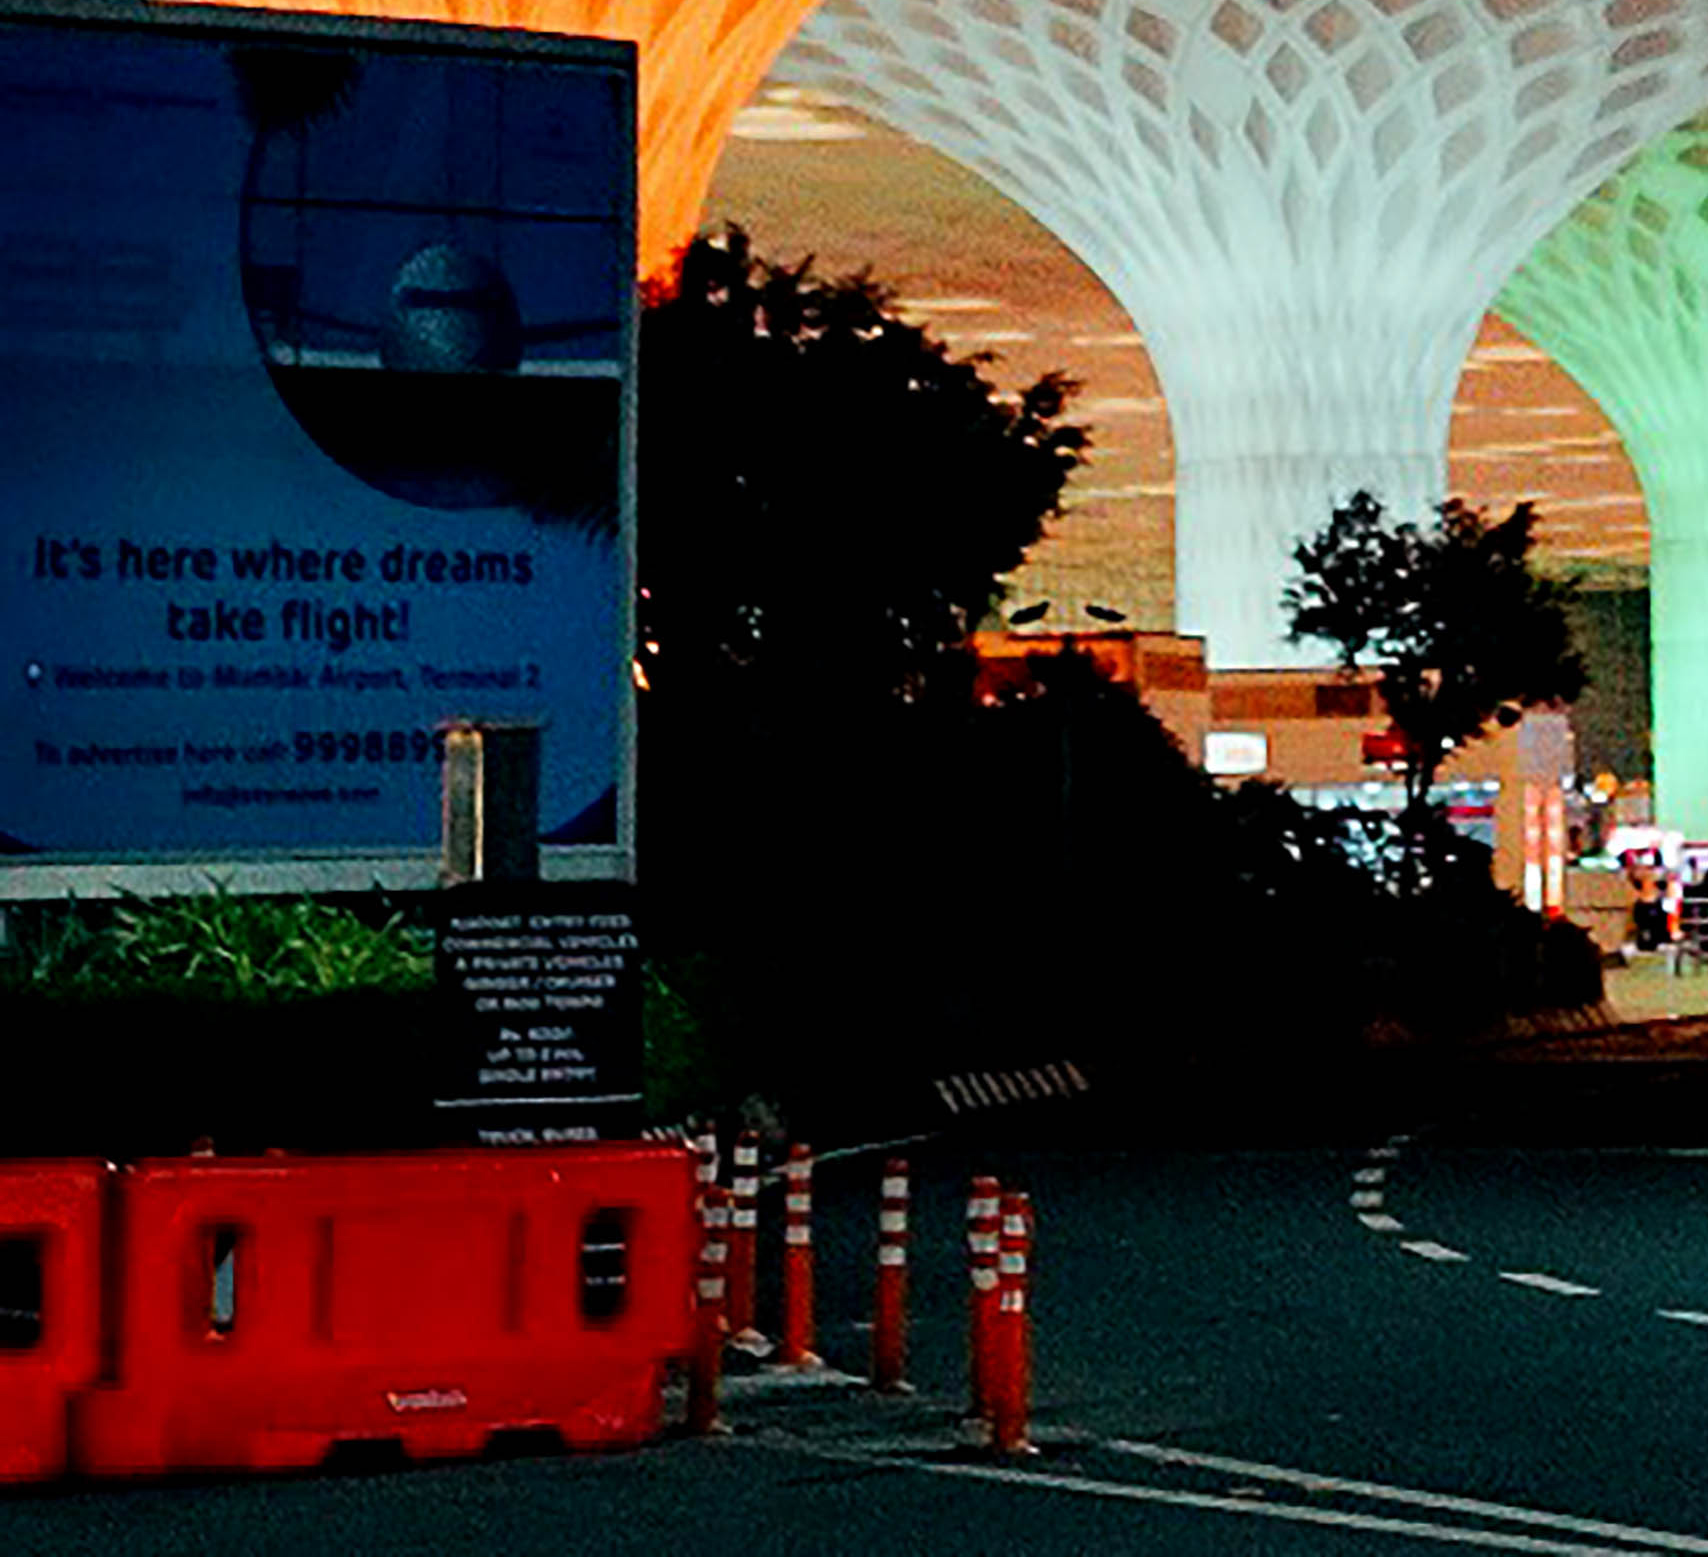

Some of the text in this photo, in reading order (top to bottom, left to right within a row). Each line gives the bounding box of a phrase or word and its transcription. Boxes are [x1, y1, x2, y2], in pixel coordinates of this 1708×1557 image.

[35, 536, 534, 585] It's here where dreams
[167, 599, 409, 652] take flight!
